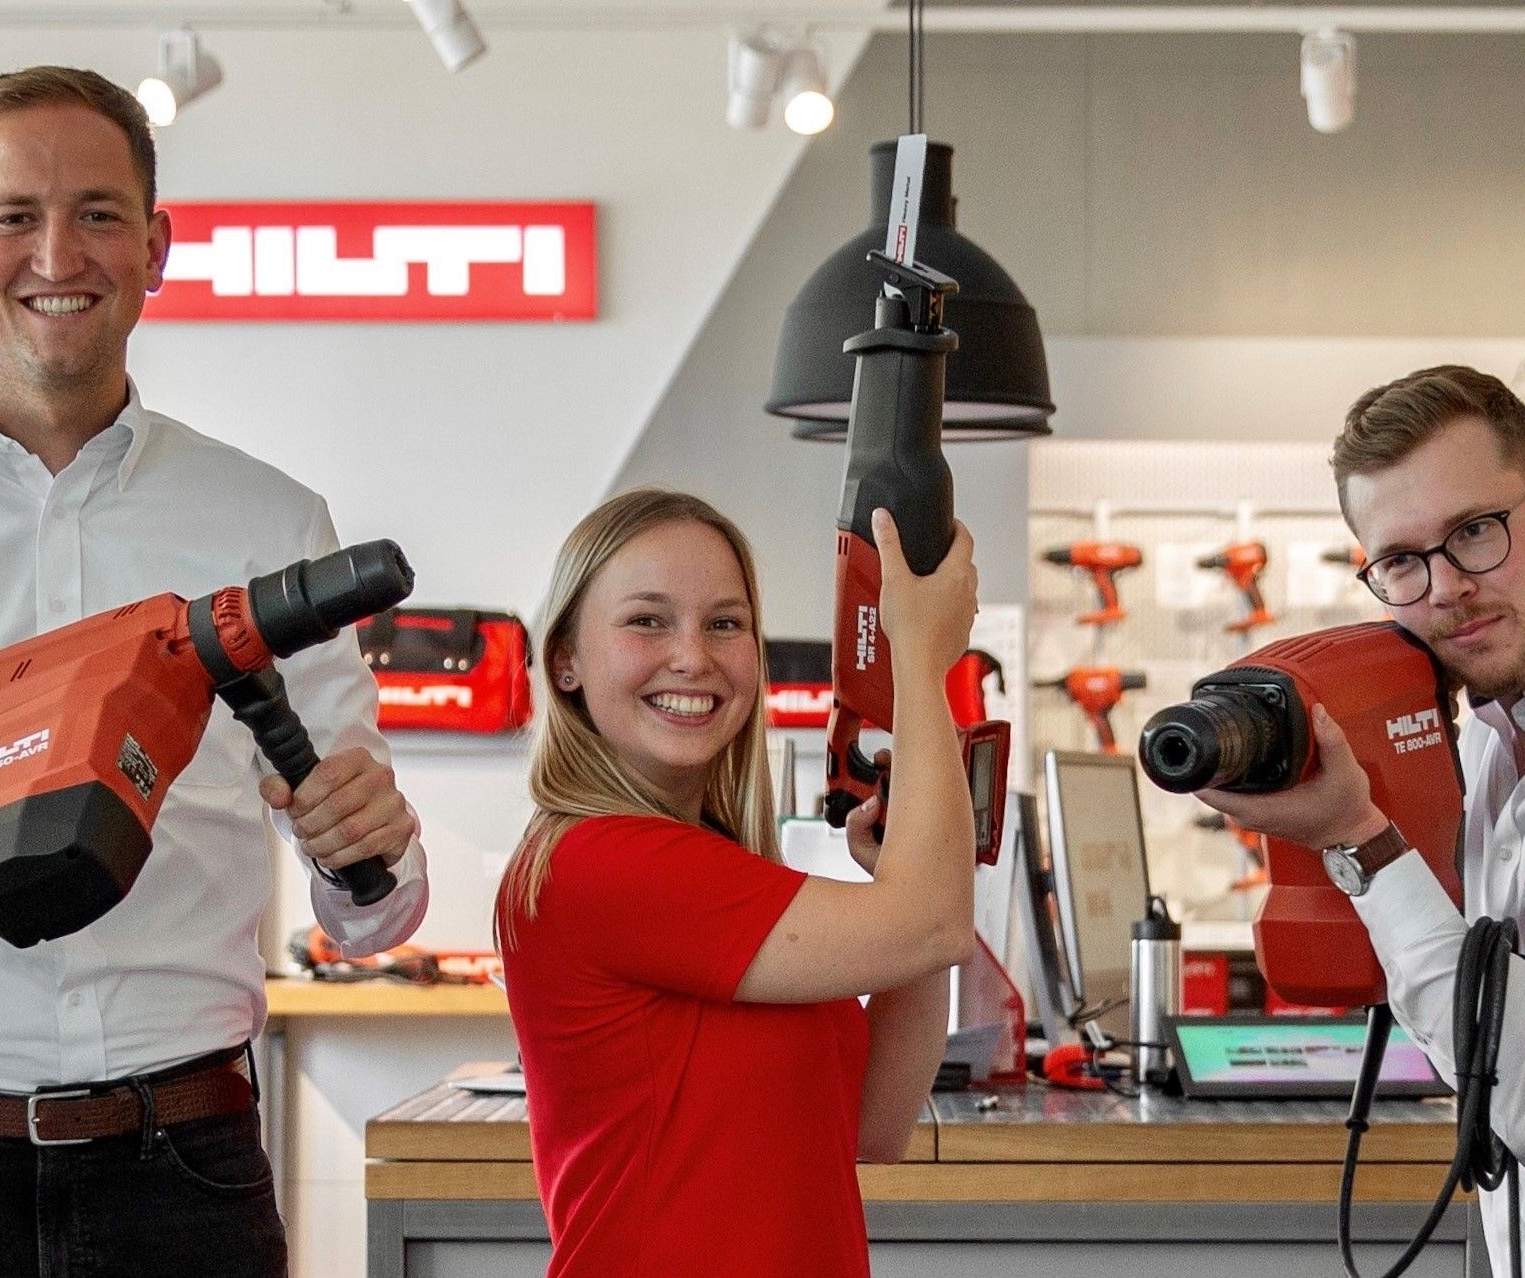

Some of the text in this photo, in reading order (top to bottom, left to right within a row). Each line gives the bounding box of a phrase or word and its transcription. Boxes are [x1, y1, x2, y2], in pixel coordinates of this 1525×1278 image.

[856, 605, 868, 671] HILTI
[1386, 708, 1439, 740] HILTI
[1394, 741, 1407, 755] TE
